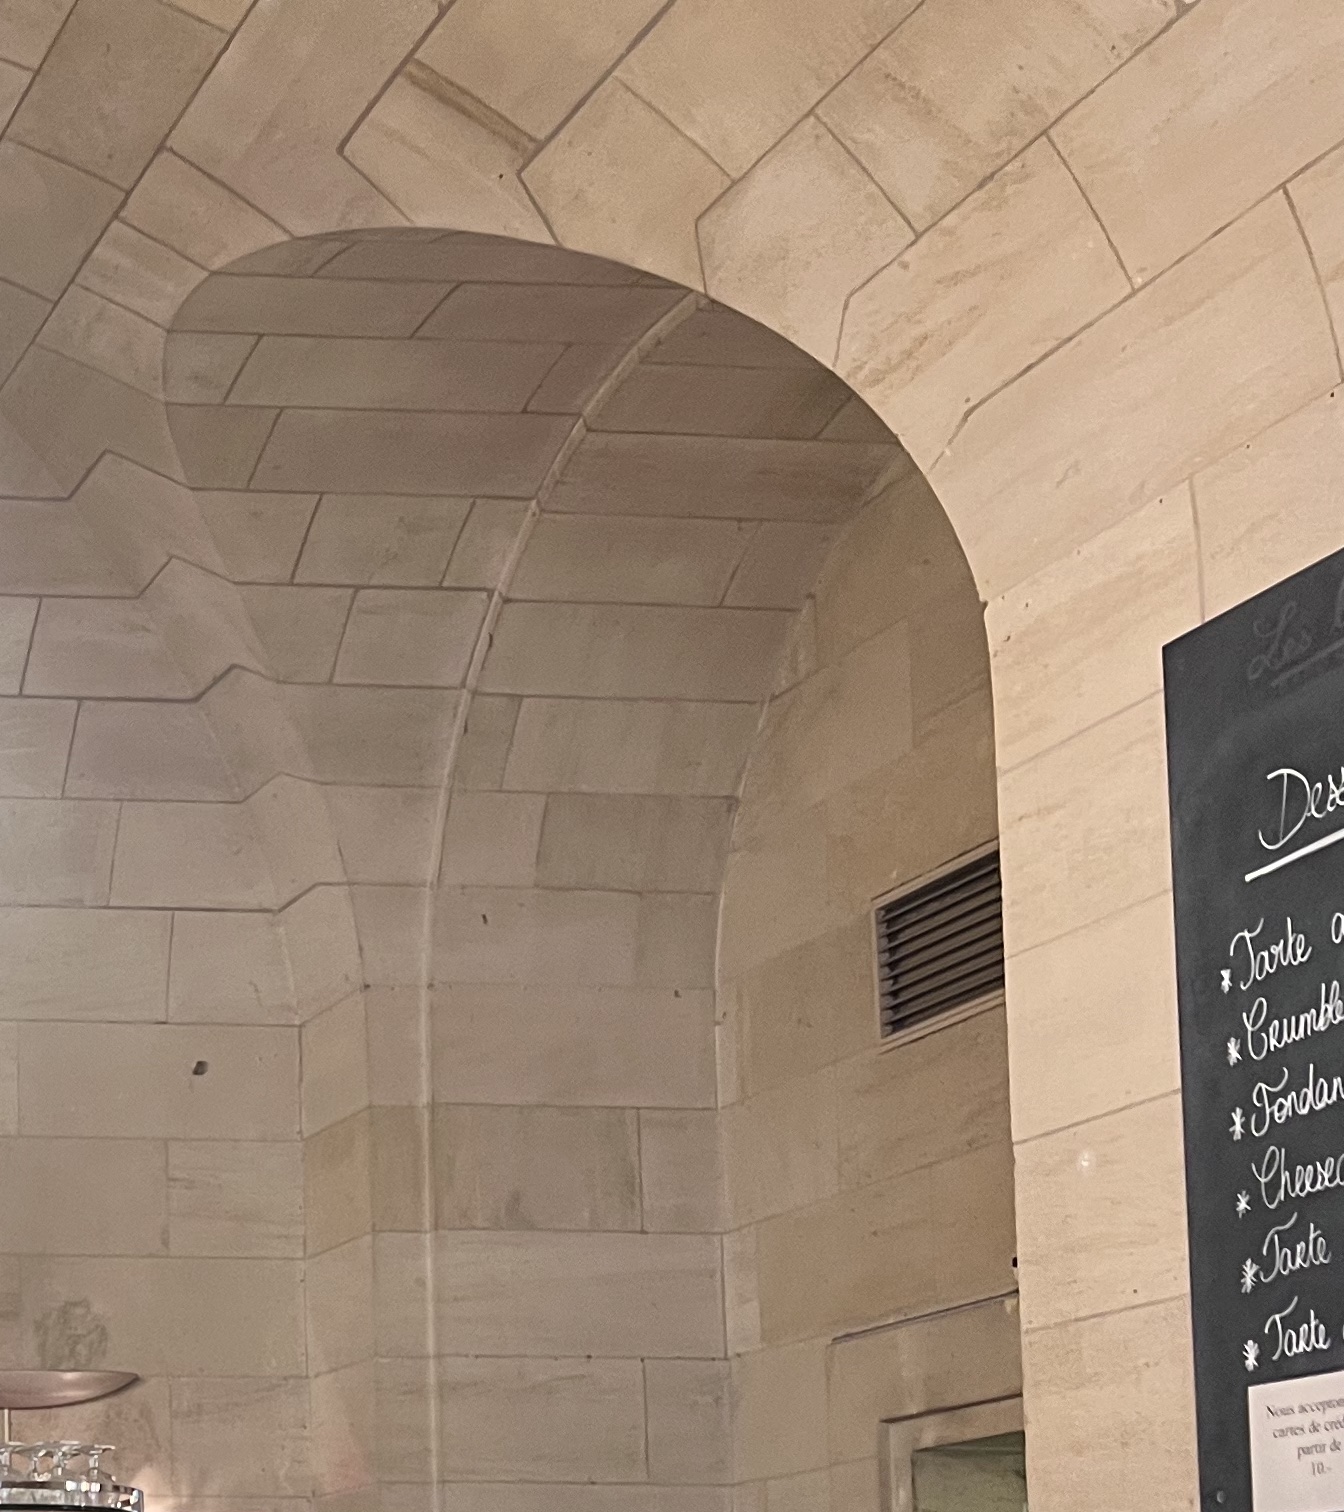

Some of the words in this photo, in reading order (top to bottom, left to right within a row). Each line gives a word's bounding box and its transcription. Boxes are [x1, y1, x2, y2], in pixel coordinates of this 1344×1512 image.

[1229, 917, 1312, 990] Tarte
[1260, 1212, 1332, 1284] Tarte
[1264, 1296, 1331, 1361] Tarte
